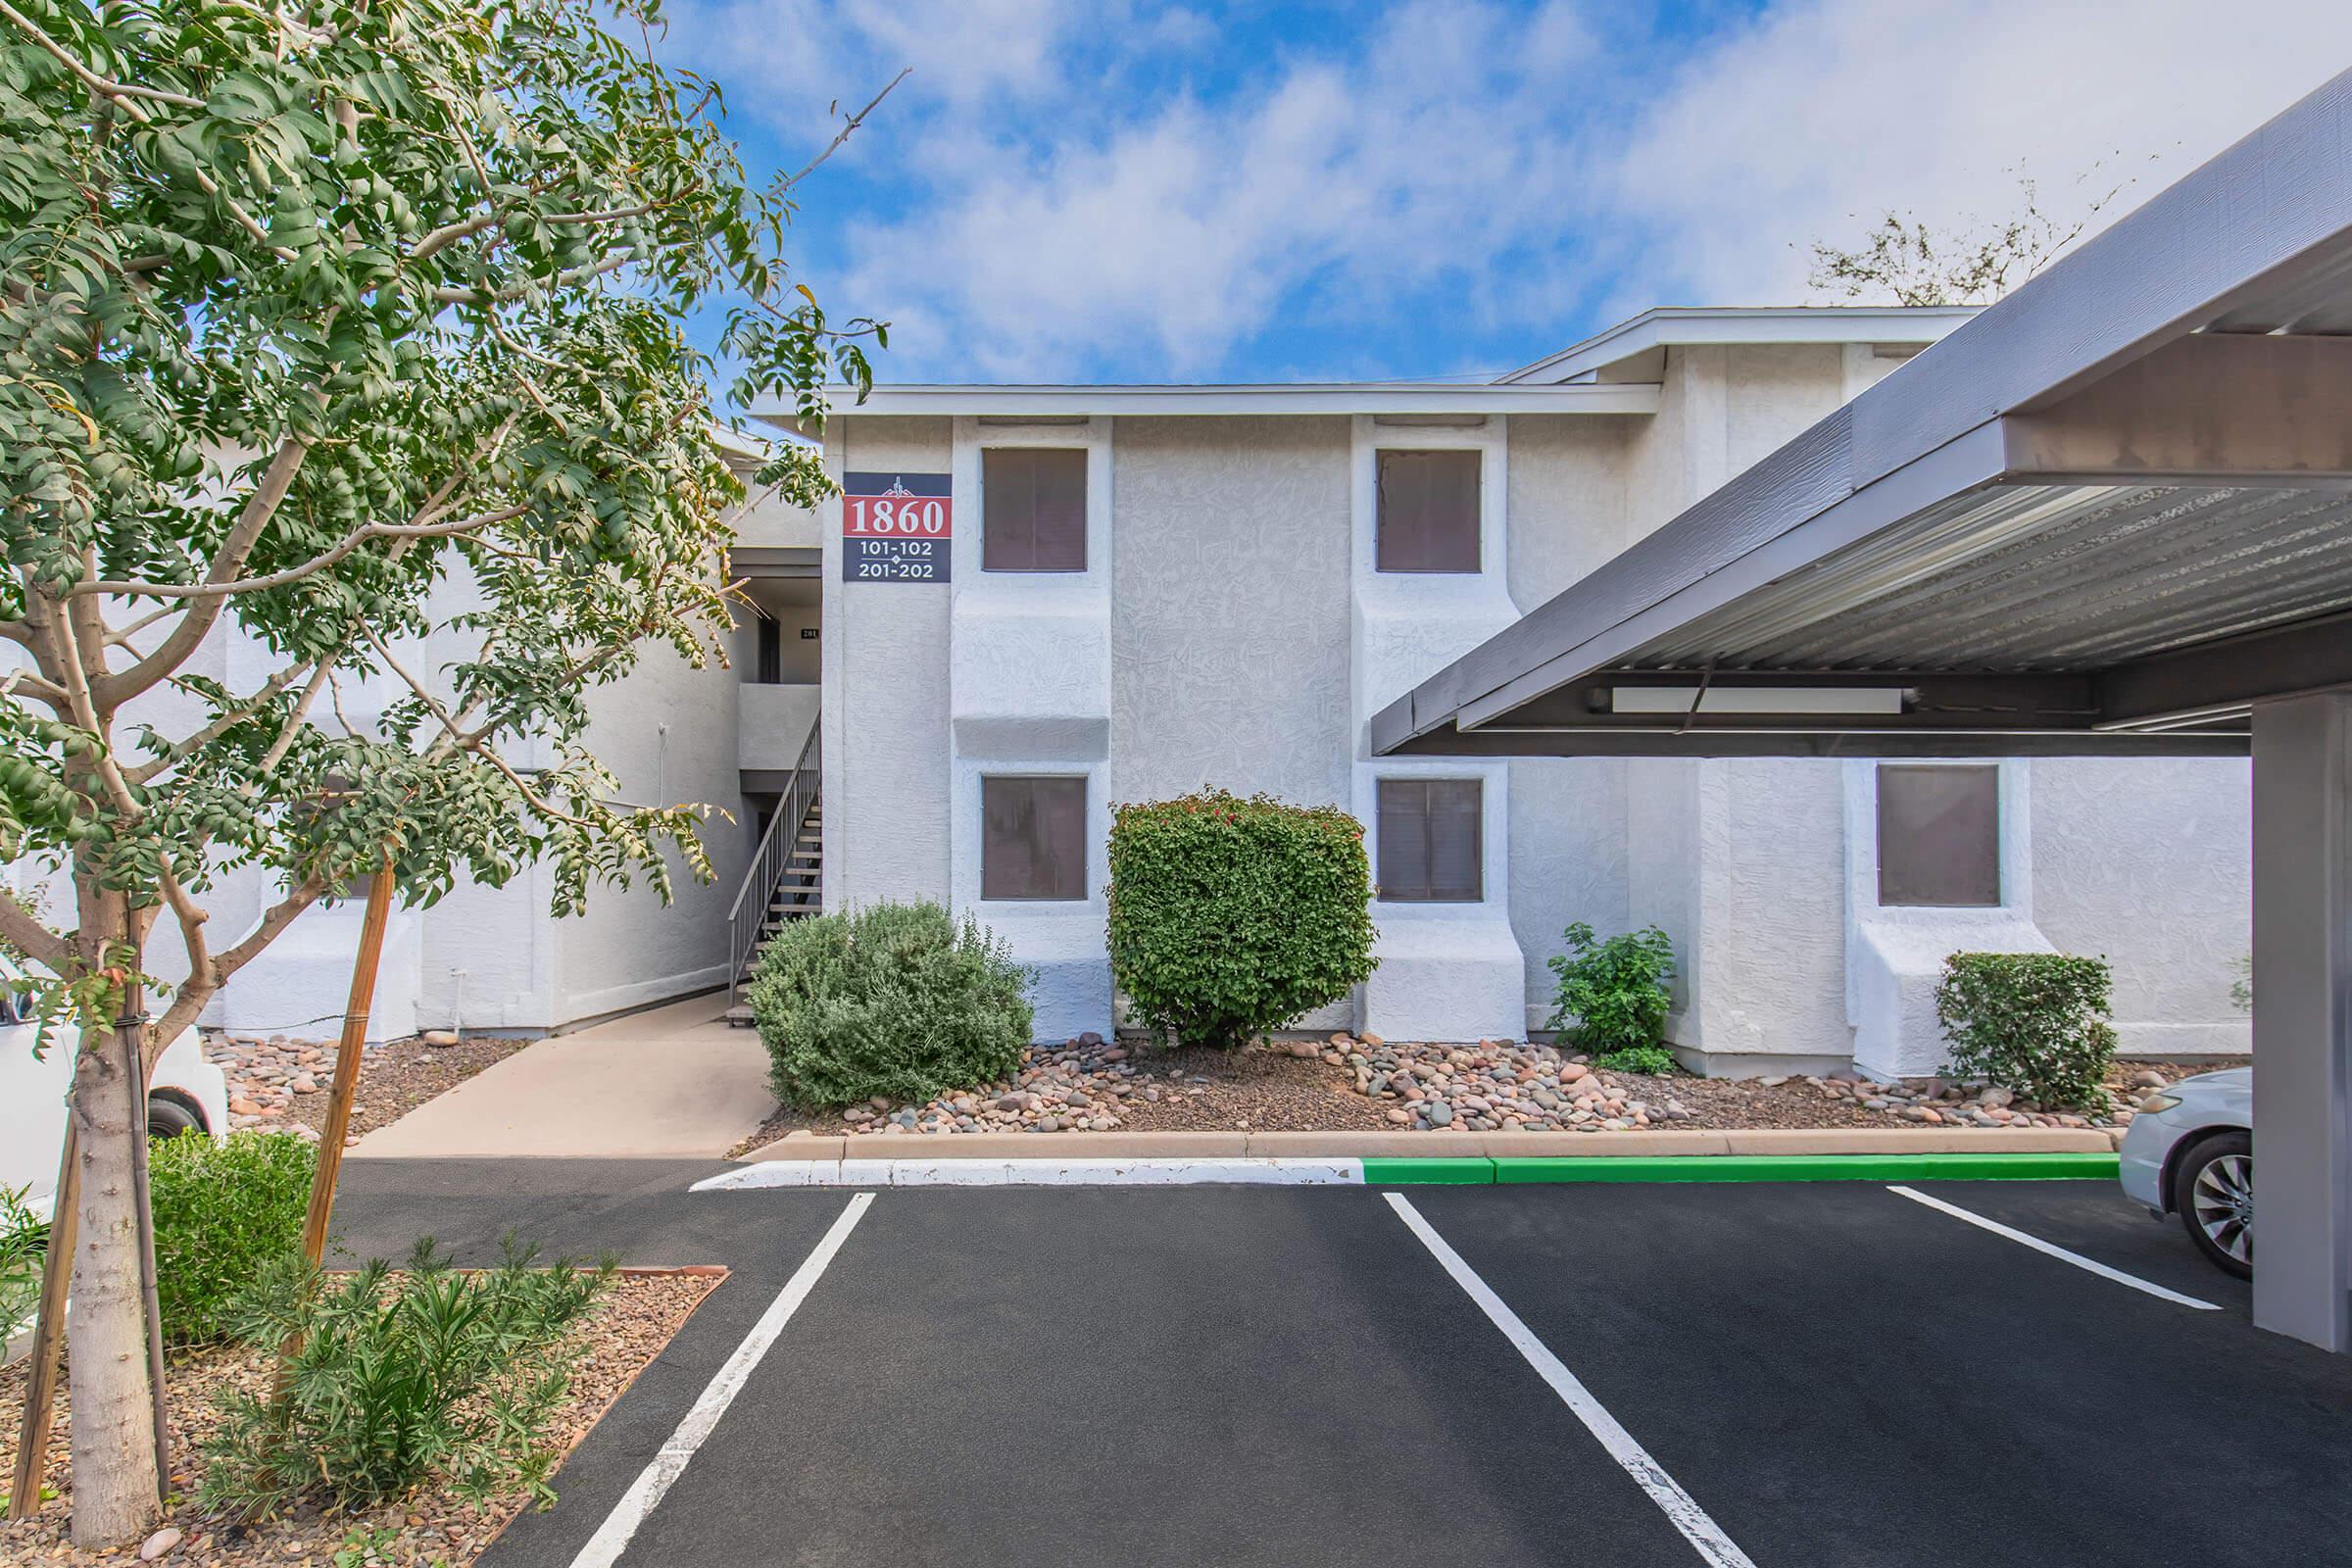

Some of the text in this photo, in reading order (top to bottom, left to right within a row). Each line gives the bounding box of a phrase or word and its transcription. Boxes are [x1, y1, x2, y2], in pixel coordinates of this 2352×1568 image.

[852, 500, 944, 533] 1860
[859, 541, 932, 556] 101-102
[858, 564, 933, 578] 201-202
